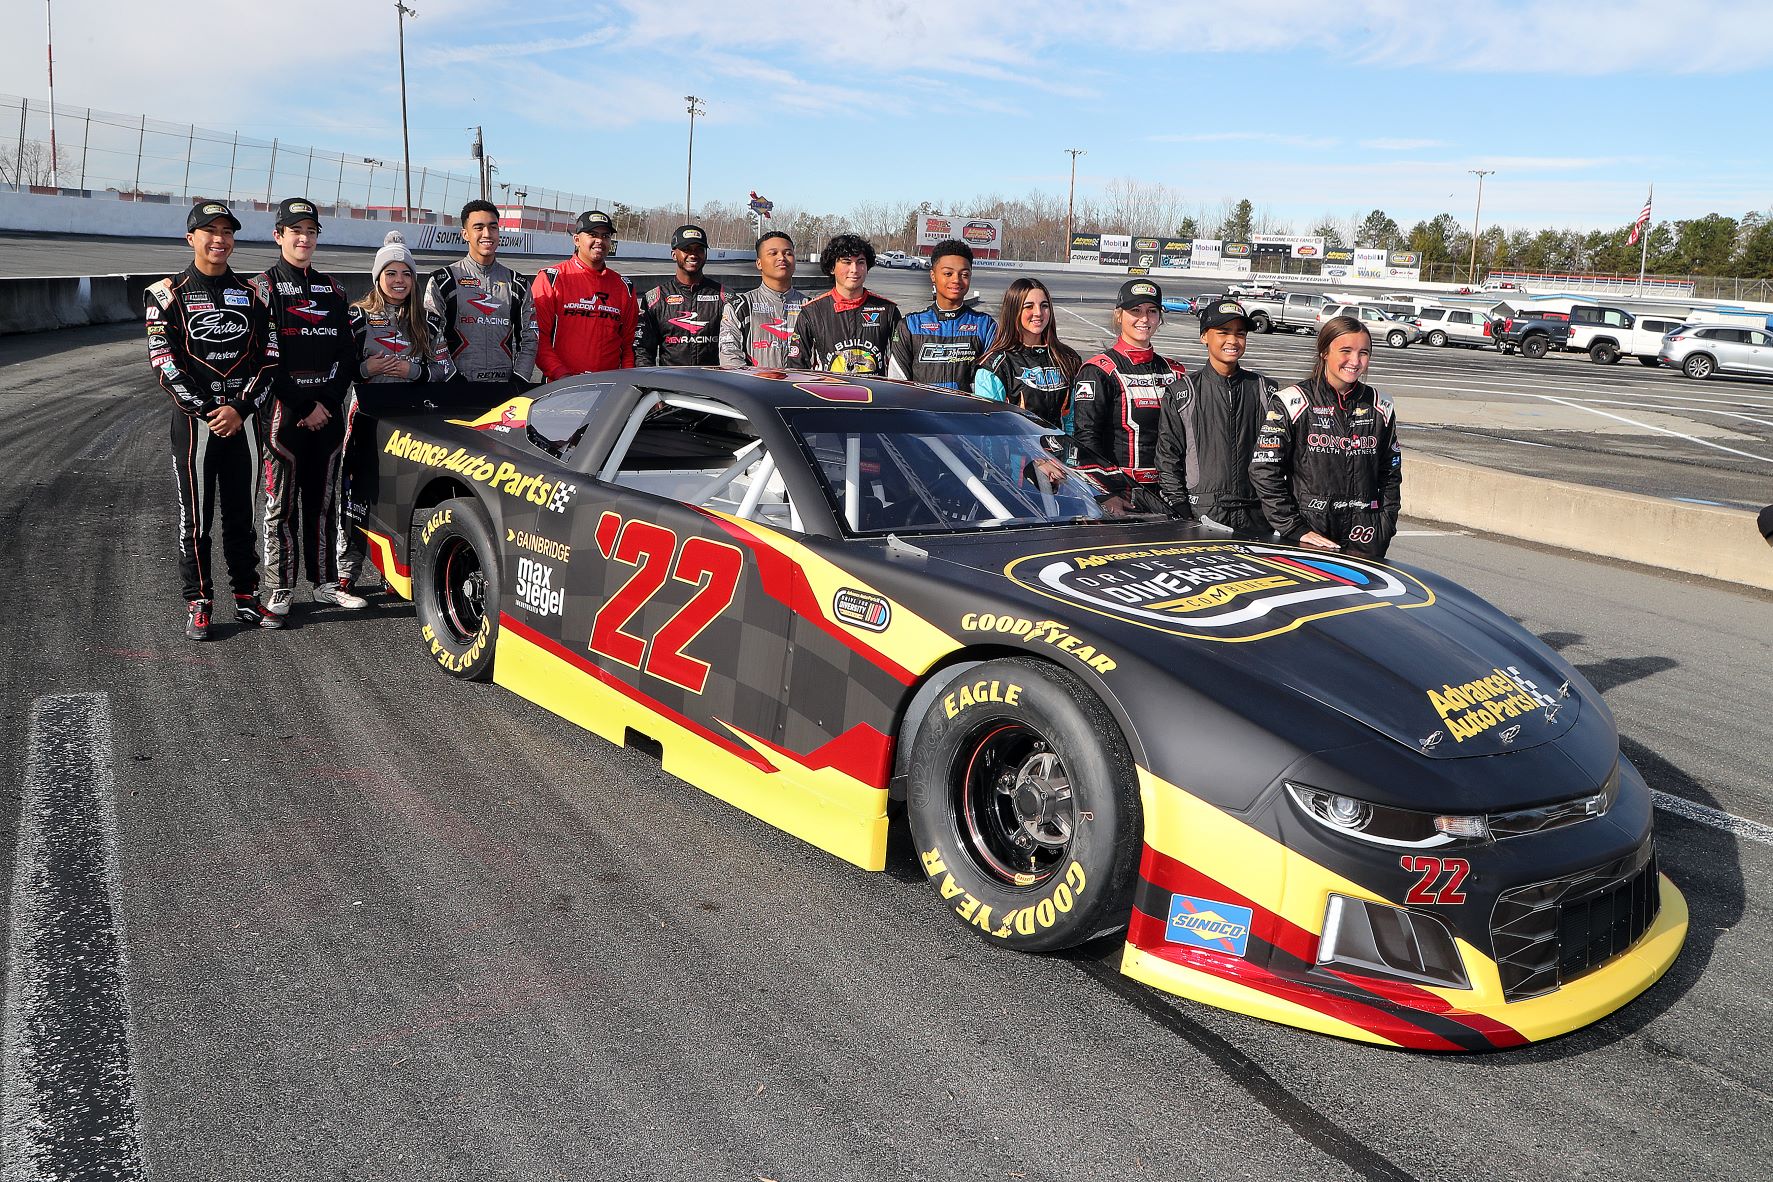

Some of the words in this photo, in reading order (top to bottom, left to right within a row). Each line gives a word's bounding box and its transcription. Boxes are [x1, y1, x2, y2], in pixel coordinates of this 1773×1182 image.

[436, 231, 461, 245] SOUTH
[498, 233, 523, 247] EEDWAY
[1103, 239, 1121, 247] Mobil
[190, 312, 247, 341] Gates
[1307, 433, 1378, 450] CONCORD
[1308, 446, 1340, 455] WEALTH
[1344, 448, 1377, 457] PARTNERS
[383, 429, 449, 467] Advance
[438, 447, 495, 482] Auto
[487, 461, 552, 506] Parts
[421, 509, 452, 546] EAGLE
[1349, 524, 1375, 544] 96
[516, 530, 571, 564] GAINBRIDGE
[1078, 547, 1147, 570] Advance
[1148, 547, 1188, 557] Auto
[517, 556, 553, 590] max
[1075, 560, 1175, 588] DRIVE
[1179, 554, 1235, 566] FOR
[1100, 562, 1267, 604] DIVERSITY
[1186, 580, 1270, 608] COMBINE
[943, 680, 1023, 720] EAGLE
[1426, 673, 1514, 720] Advance
[1443, 708, 1497, 743] Auto
[1481, 693, 1535, 723] Parts
[1173, 914, 1244, 938] SUNOCO
